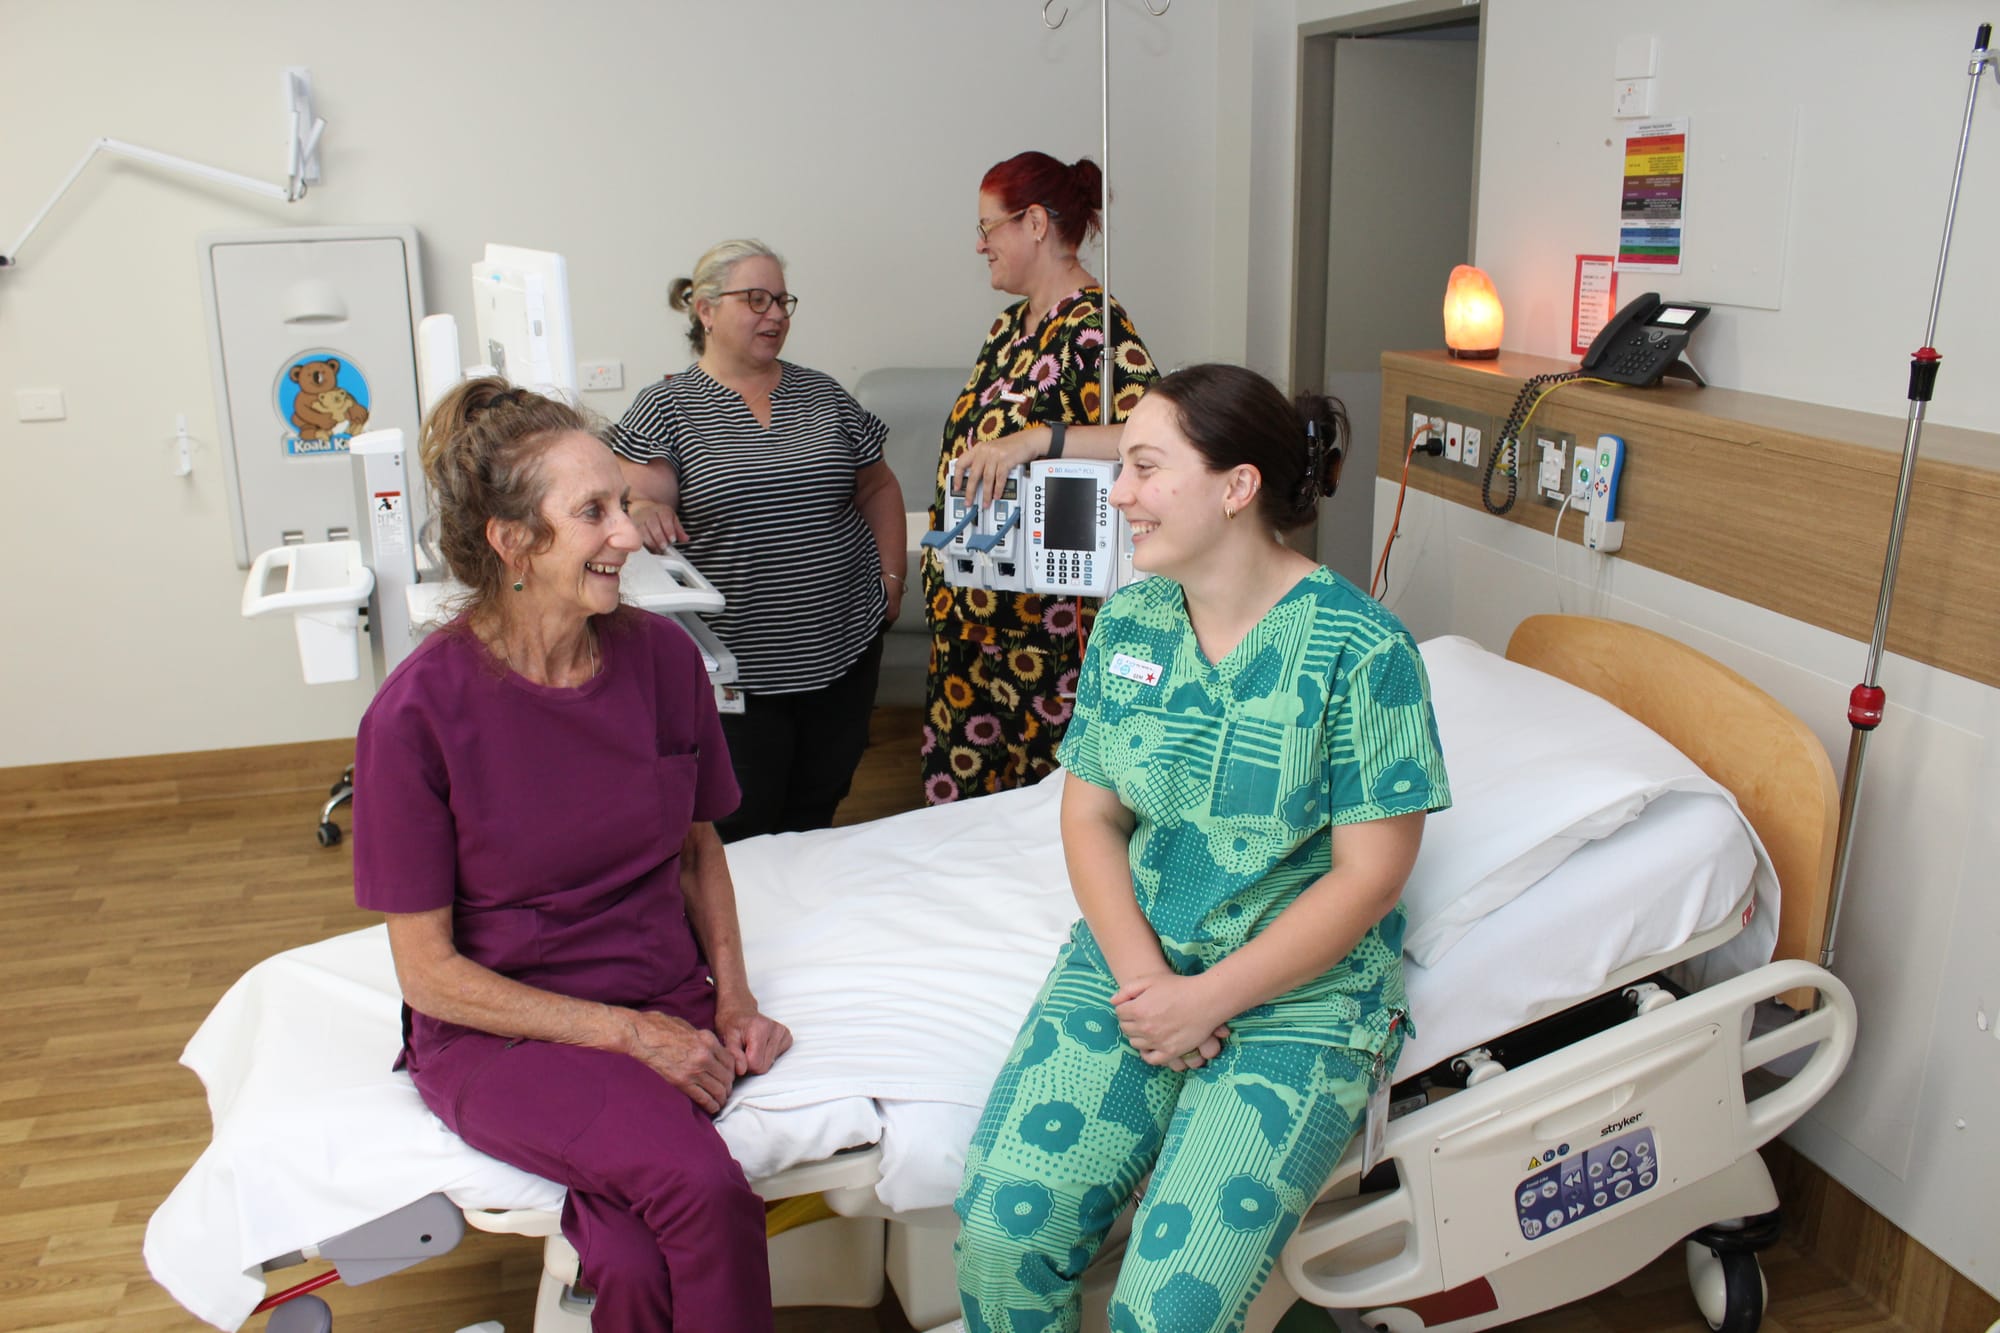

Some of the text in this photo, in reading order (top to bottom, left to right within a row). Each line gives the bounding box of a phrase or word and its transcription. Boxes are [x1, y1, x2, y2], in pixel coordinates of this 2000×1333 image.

[294, 437, 351, 454] Koala Ka
[1599, 1111, 1644, 1137] stryker
